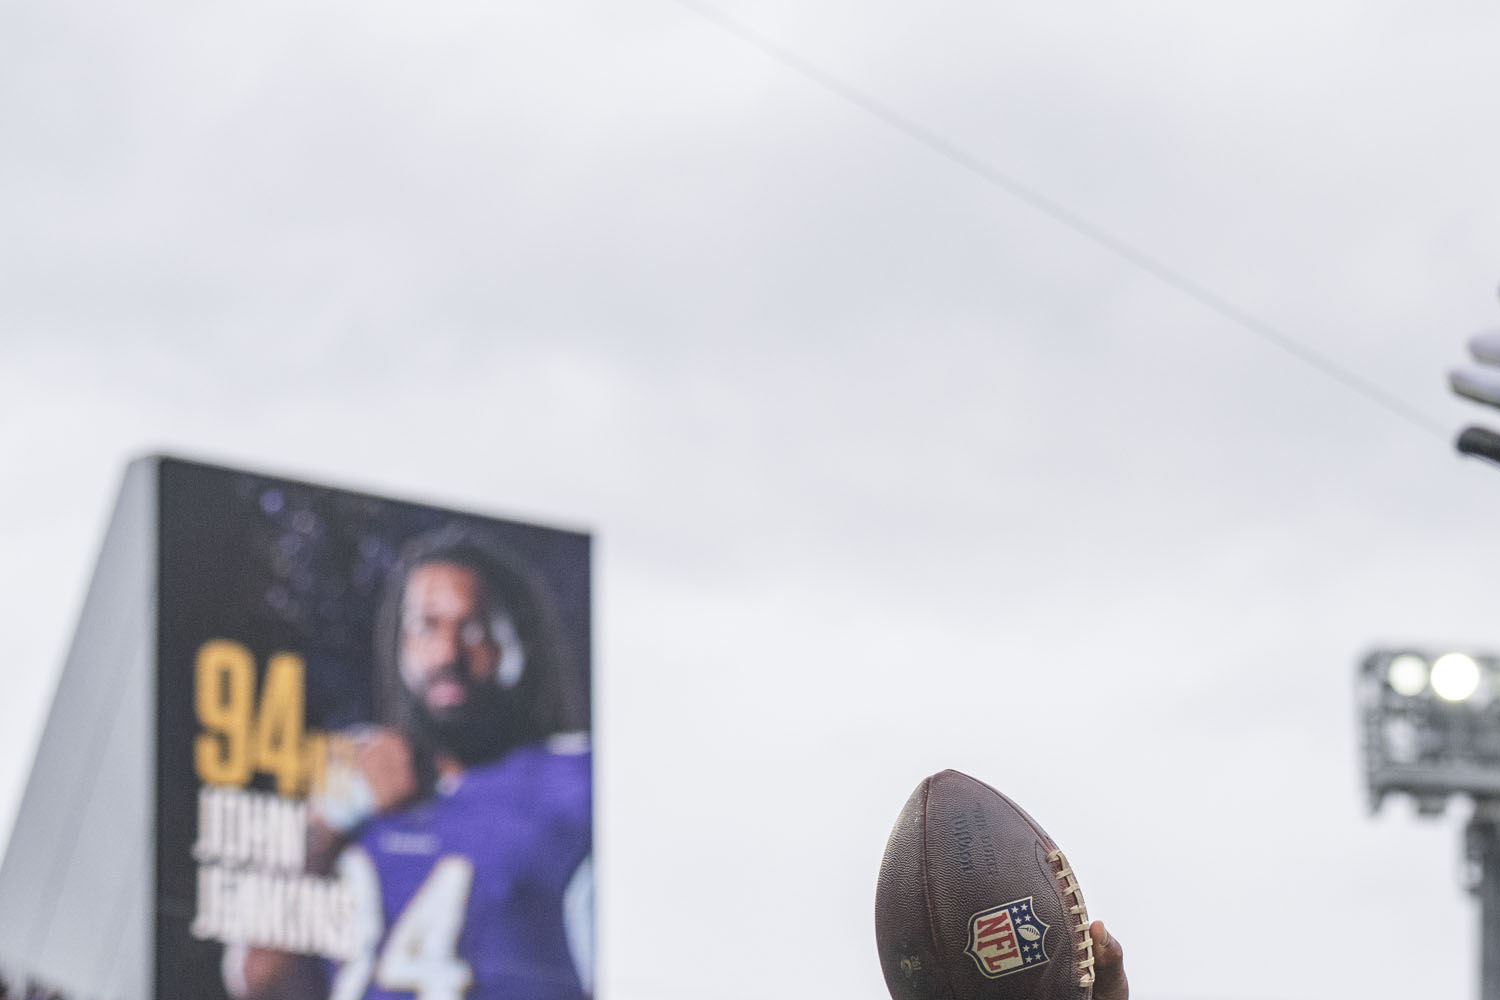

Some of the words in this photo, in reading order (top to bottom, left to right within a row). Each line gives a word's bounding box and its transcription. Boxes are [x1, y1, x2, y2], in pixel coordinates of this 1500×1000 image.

[194, 638, 306, 798] 94
[193, 783, 306, 871] JOHN
[976, 911, 1021, 973] NFL
